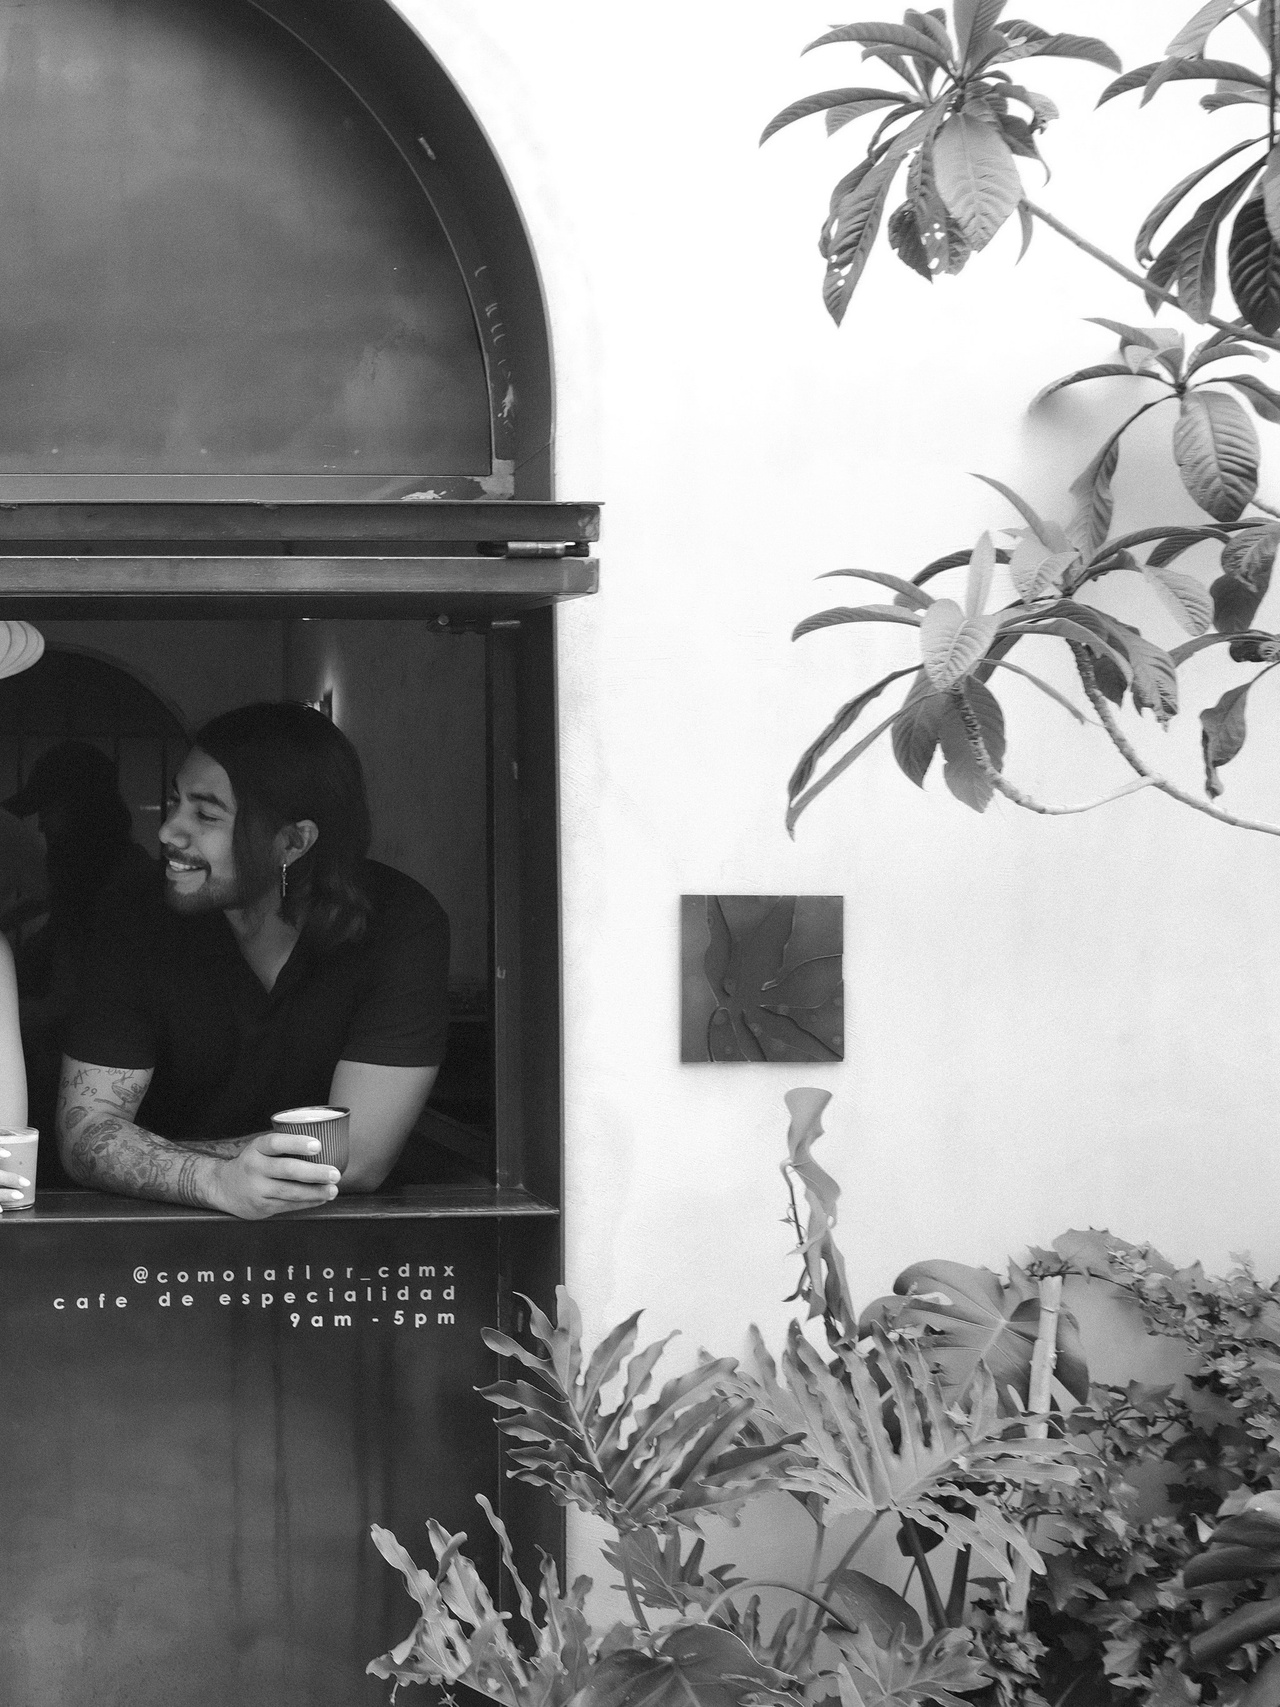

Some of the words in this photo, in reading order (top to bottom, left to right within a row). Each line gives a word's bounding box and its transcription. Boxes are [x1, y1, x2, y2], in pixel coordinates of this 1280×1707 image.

[132, 1262, 455, 1284] @comolaflor_cdmx
[52, 1292, 128, 1310] cafe
[158, 1291, 194, 1308] de
[218, 1285, 455, 1309] especialidad
[289, 1312, 352, 1328] 9am
[393, 1309, 455, 1329] 5pm
